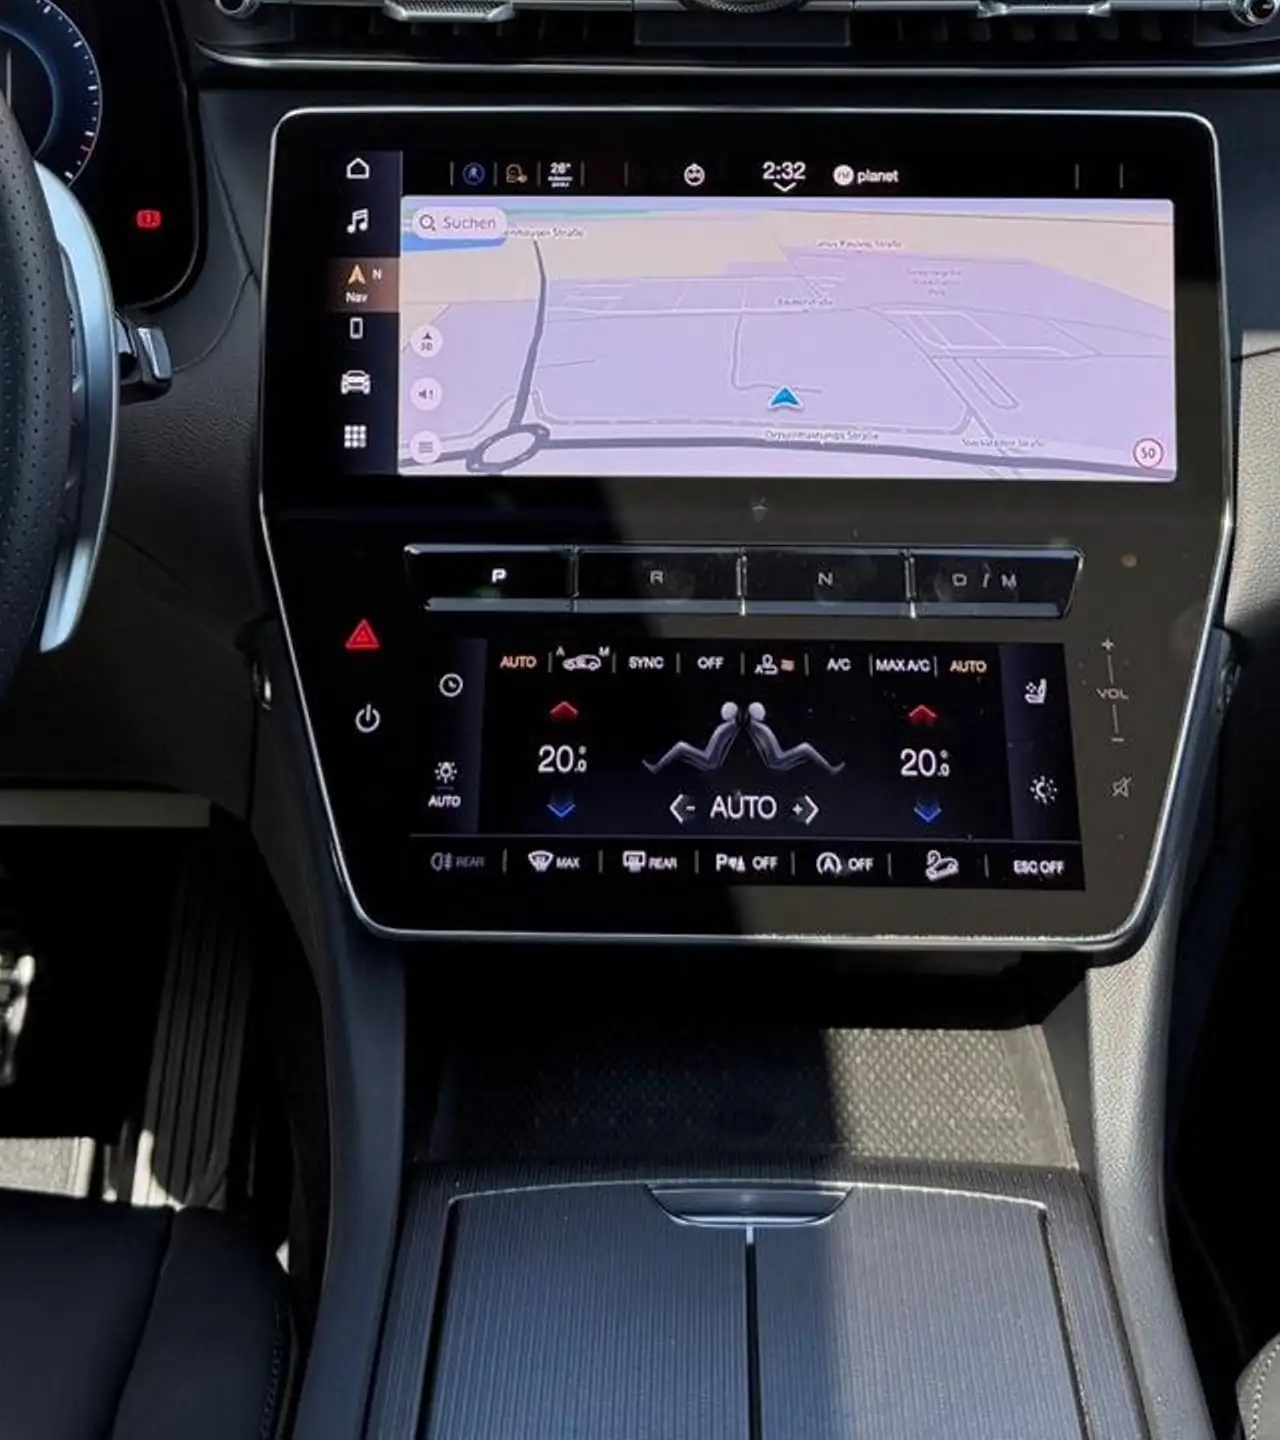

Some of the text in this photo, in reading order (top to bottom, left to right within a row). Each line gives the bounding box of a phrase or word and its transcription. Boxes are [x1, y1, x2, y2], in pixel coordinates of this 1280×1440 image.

[762, 161, 806, 180] 2:32
[857, 169, 899, 184] planet
[443, 215, 496, 230] Suchen
[346, 291, 368, 303] Nav
[1140, 446, 1157, 461] 50
[491, 568, 507, 583] P
[649, 570, 664, 584] R
[818, 572, 834, 586] N
[952, 573, 968, 588] D
[1001, 573, 1018, 588] M
[500, 656, 538, 669] AUTO
[628, 656, 665, 670] SYNC
[697, 656, 724, 670] OFF
[826, 657, 852, 671] A/C
[875, 658, 931, 672] MAX A/C
[950, 659, 987, 673] AUTO
[1096, 687, 1130, 700] VOL
[428, 795, 461, 808] AUTO
[710, 796, 777, 820] AUTO
[456, 855, 485, 869] REAR
[556, 855, 581, 869] MAX
[648, 856, 678, 870] REAR
[752, 855, 778, 870] OFF
[848, 857, 874, 872] OFF
[1039, 860, 1065, 875] OFF
